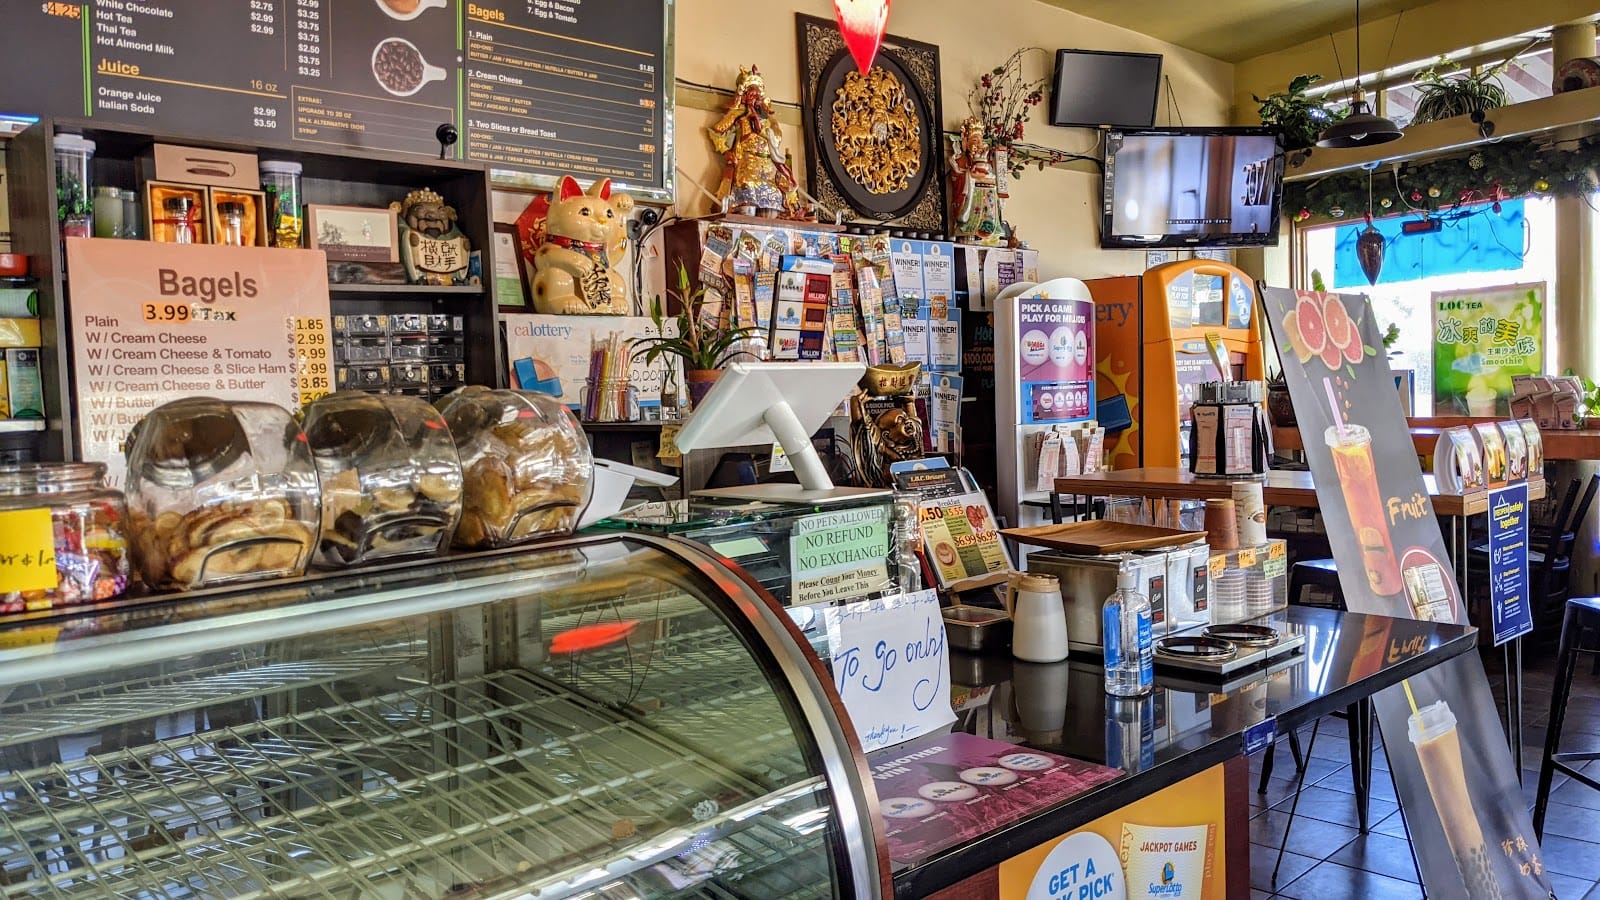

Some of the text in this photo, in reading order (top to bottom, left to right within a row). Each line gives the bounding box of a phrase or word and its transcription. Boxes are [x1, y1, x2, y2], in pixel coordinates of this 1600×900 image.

[96, 0, 174, 18] White Chocolate
[250, 0, 273, 11] $2.75
[554, 2, 575, 13] Bacon
[96, 10, 134, 24] Hot Tea
[250, 11, 274, 23] $2.99
[297, 9, 320, 20] $3.25
[468, 3, 506, 22] Bagels
[534, 8, 548, 18] Egg
[554, 12, 578, 24] Tomato
[97, 23, 138, 38] Thai Tea
[251, 23, 275, 35] $2.99
[297, 21, 320, 32] $3.75
[298, 32, 321, 43] $3.75
[476, 31, 493, 42] Plain
[97, 35, 175, 55] Hot Almond Milk
[298, 44, 321, 55] $2.50
[98, 58, 140, 76] Juice
[298, 55, 321, 67] $3.75
[298, 67, 321, 78] $3.25
[468, 69, 523, 86] 2. Cream Cheese
[249, 79, 278, 92] 16 oz
[98, 86, 161, 103] Orange Juice
[98, 99, 155, 115] Italian Soda
[253, 106, 276, 118] $2.99
[253, 118, 277, 130] $3.50
[476, 121, 490, 130] Two
[491, 122, 510, 132] Slices
[512, 126, 519, 134] or
[540, 129, 557, 139] Toast
[895, 258, 920, 267] WINNER!
[157, 267, 259, 304] Bagels
[145, 303, 189, 320] 3.99
[1022, 304, 1042, 313] PICK
[1044, 304, 1050, 313] A
[1439, 299, 1483, 311] LOC TEA
[85, 315, 119, 328] Plain
[1022, 314, 1044, 323] PLAY
[1045, 314, 1062, 323] FOR
[514, 321, 573, 340] calottery
[930, 326, 958, 334] WINNER!
[85, 332, 101, 344] W
[111, 332, 156, 344] Cream
[158, 332, 208, 344] Cheese
[86, 348, 102, 360] W
[112, 348, 157, 360] Cream
[160, 348, 208, 360] Cheese
[212, 348, 222, 360] &
[225, 348, 272, 360] Tomato
[1481, 357, 1523, 366] Smoothie
[88, 362, 286, 376] W Cream Cheese & Slice Ham
[90, 380, 104, 393] W
[114, 380, 159, 392] Cream
[162, 380, 211, 392] Cheese
[215, 379, 226, 391] &
[228, 378, 265, 391] Butter
[90, 396, 156, 409] W Butter
[92, 414, 107, 426] W
[1386, 492, 1428, 526] Fruit
[800, 508, 883, 532] NO PETS ALLOWED
[806, 525, 874, 550] NO REFUND
[800, 544, 885, 571] NO EXCHANGE
[799, 568, 878, 590] Please Count Your Money
[799, 580, 870, 602] Before You Leave This
[834, 616, 944, 711] To go only
[873, 766, 912, 781] WIN
[1140, 840, 1198, 853] JACKPOT GAMES
[1048, 857, 1096, 896] GET A
[1079, 871, 1114, 900] PICK
